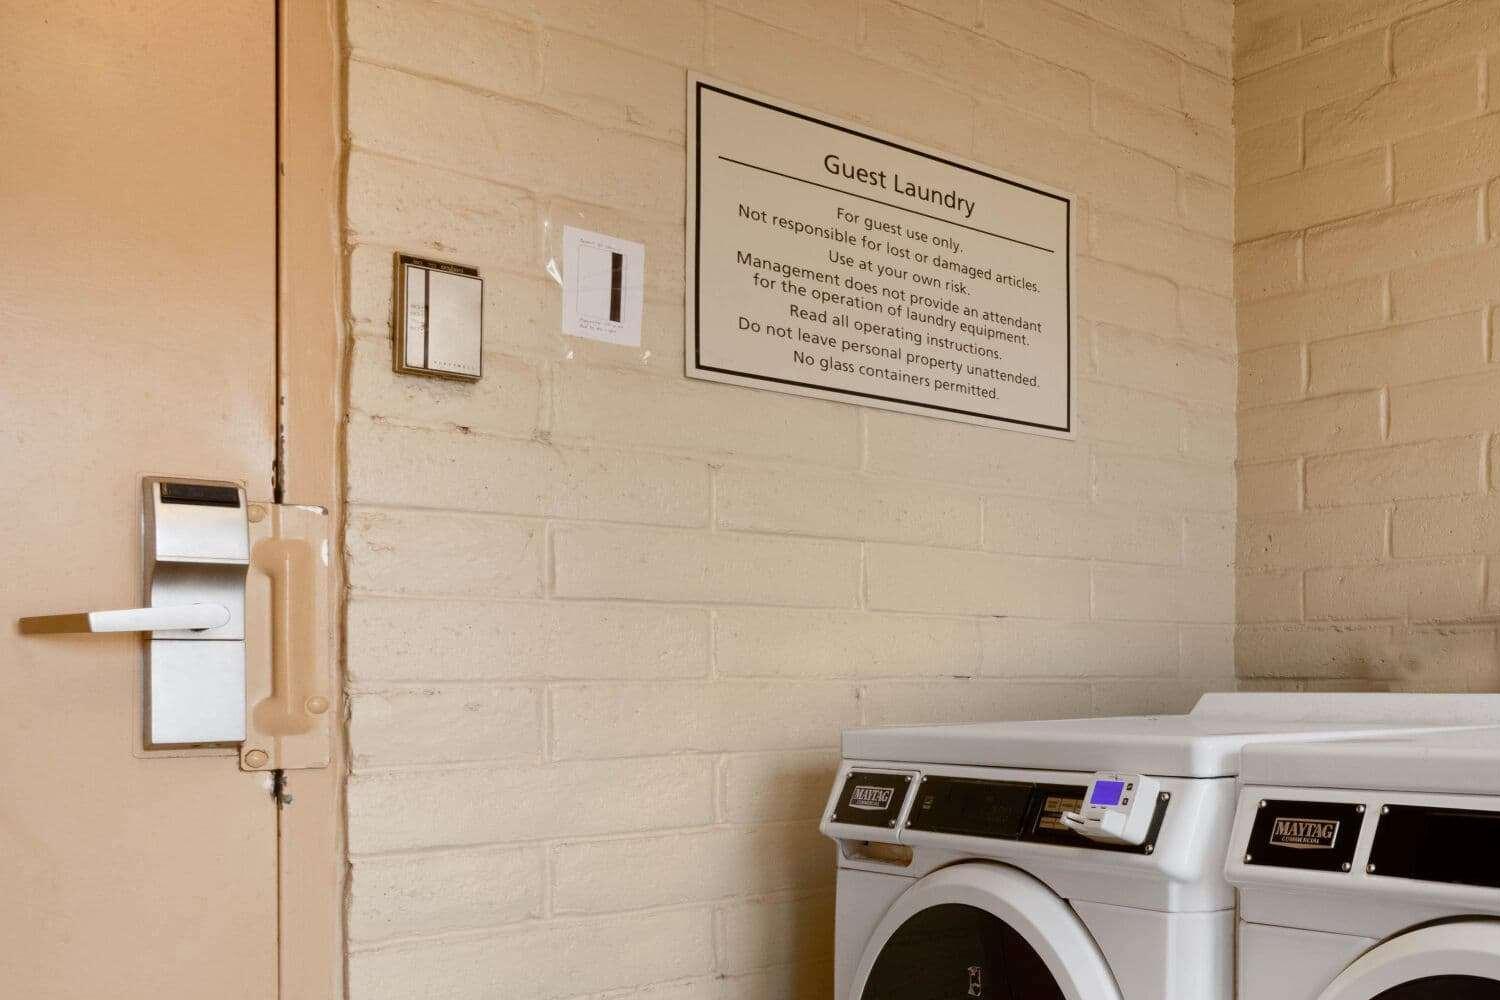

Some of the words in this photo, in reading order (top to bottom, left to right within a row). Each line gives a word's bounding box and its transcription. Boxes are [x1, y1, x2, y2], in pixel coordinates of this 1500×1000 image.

[824, 154, 887, 189] Guest
[894, 174, 975, 219] Laundry
[739, 203, 767, 224] Not
[772, 216, 857, 246] responsible
[861, 235, 882, 251] for
[886, 241, 911, 260] lost
[914, 252, 929, 264] or
[932, 255, 992, 280] damaged
[994, 273, 1040, 293] articles.
[837, 207, 860, 224] For
[864, 217, 902, 239] guest
[906, 229, 928, 243] use
[932, 236, 963, 254] only.
[737, 250, 840, 287] Management
[844, 276, 878, 295] does
[882, 287, 906, 302] not
[910, 294, 960, 314] provide
[963, 306, 979, 318] an
[982, 311, 1042, 333] attendant
[829, 249, 855, 267] Use
[858, 260, 873, 272] at
[877, 264, 908, 280] your
[912, 273, 941, 288] own
[945, 279, 970, 296] risk.
[753, 272, 776, 290] for
[781, 280, 807, 297] the
[811, 289, 883, 313] operation
[887, 304, 902, 317] of
[906, 307, 956, 332] laundry
[959, 322, 1029, 346] equipment.
[790, 304, 827, 324] Read
[832, 314, 849, 328] all
[854, 321, 922, 346] operating
[926, 332, 1002, 360] instructions.
[739, 316, 761, 333] Do
[766, 325, 793, 340] not
[798, 327, 837, 348] leave
[841, 340, 902, 360] personal
[906, 353, 963, 375] property
[966, 365, 1040, 388] unattended.
[794, 350, 815, 366] No
[819, 356, 855, 373] glass
[858, 365, 930, 387] containers
[934, 379, 999, 400] permitted.
[854, 787, 890, 802] MAYTAG
[1275, 821, 1334, 839] MAYTAG
